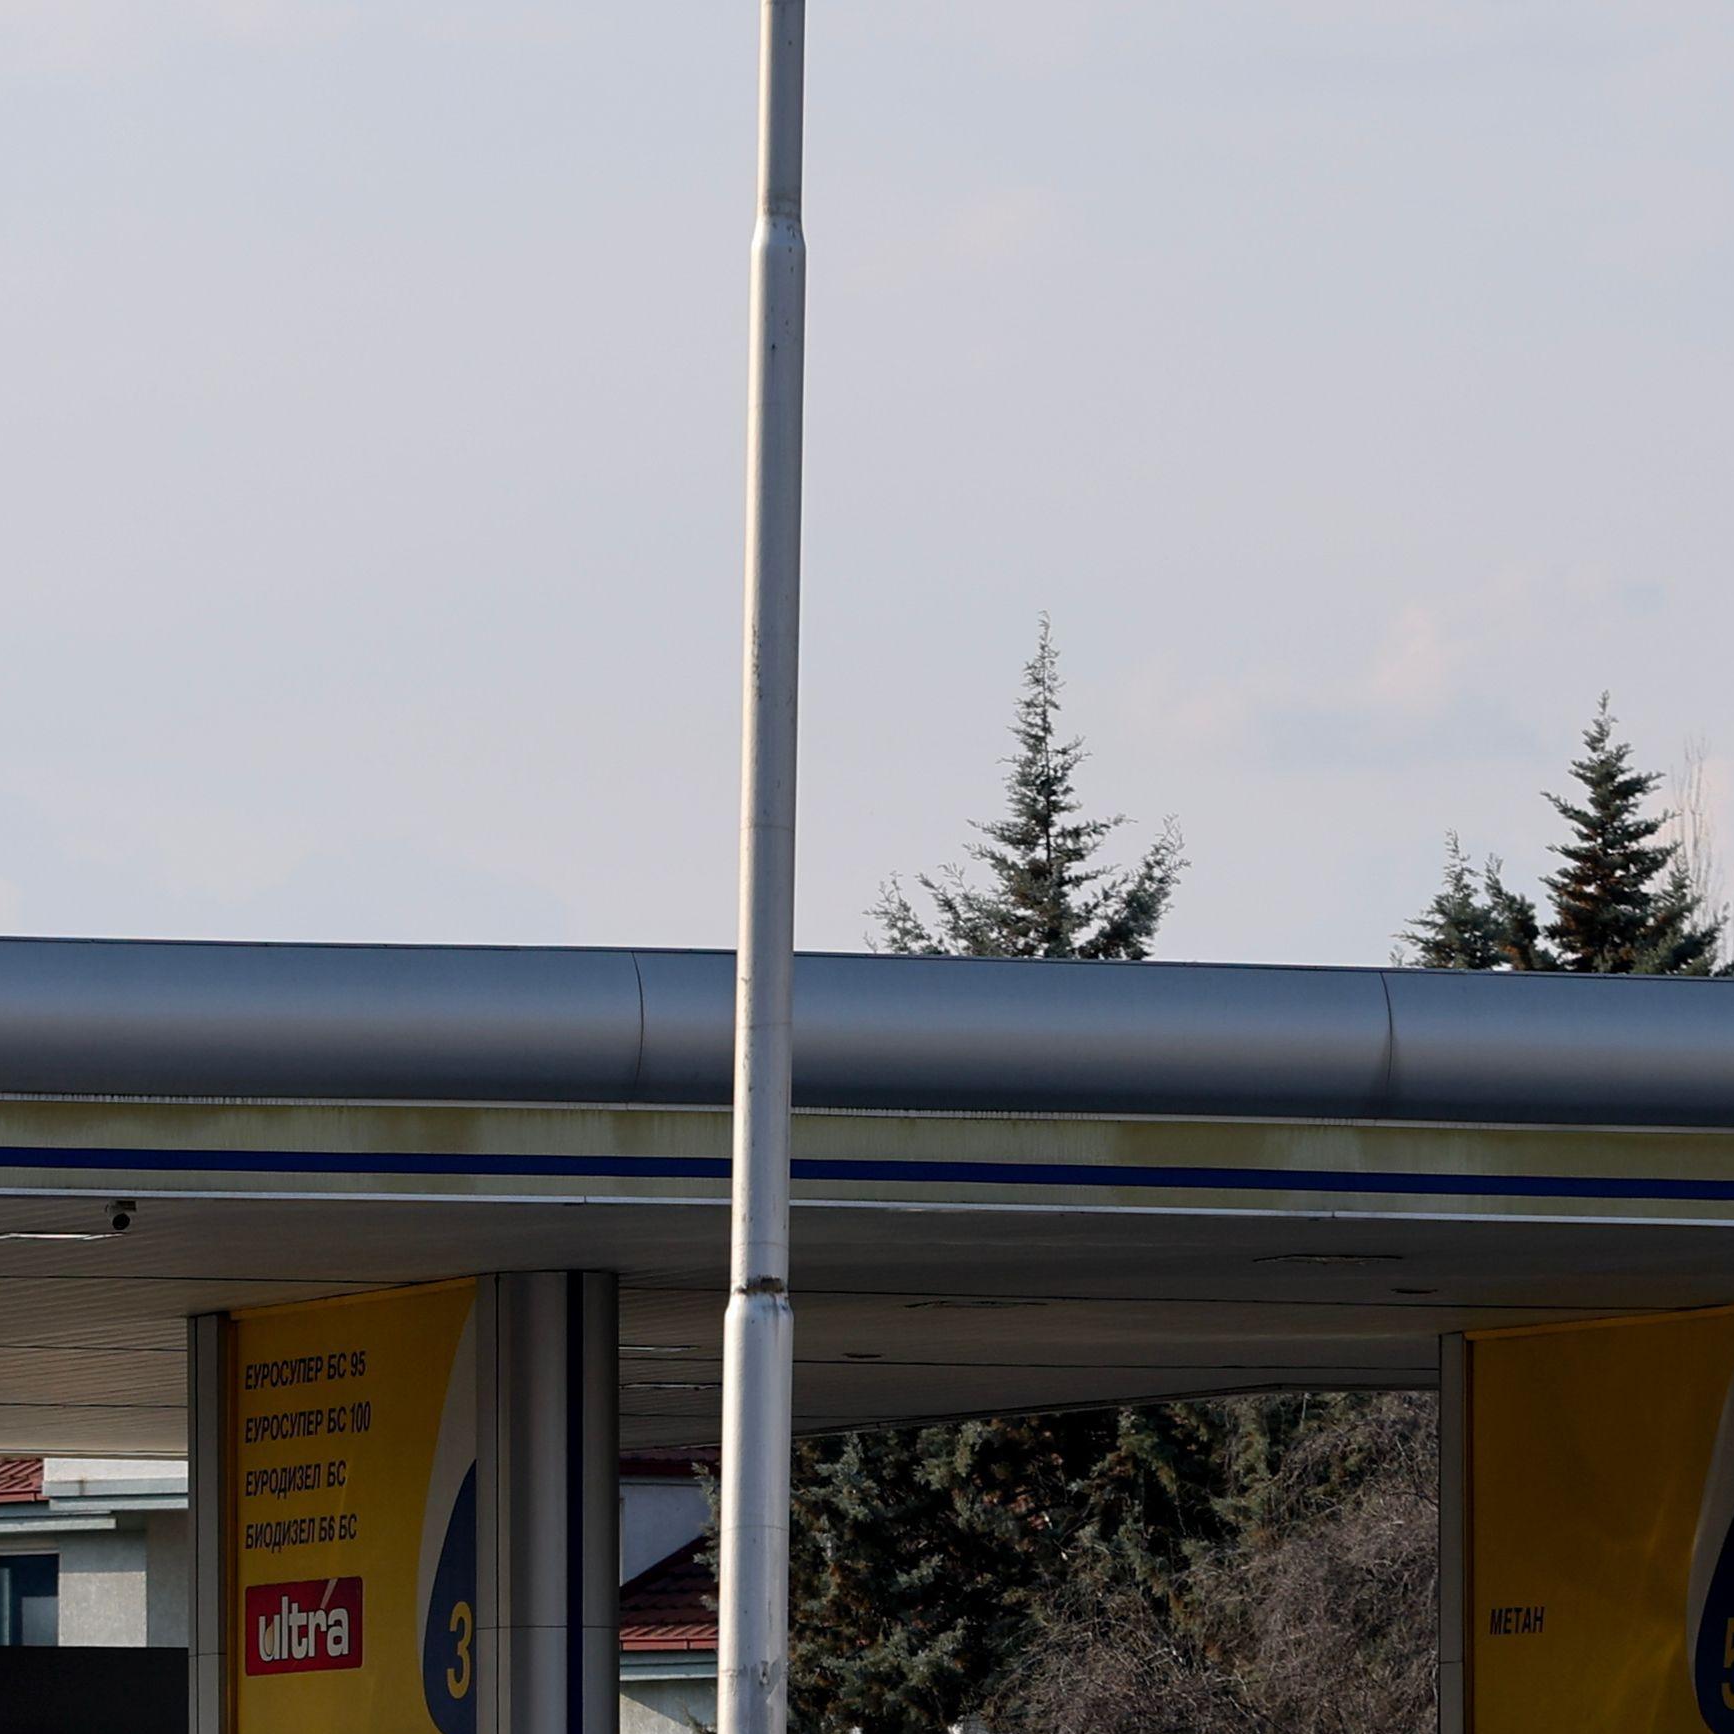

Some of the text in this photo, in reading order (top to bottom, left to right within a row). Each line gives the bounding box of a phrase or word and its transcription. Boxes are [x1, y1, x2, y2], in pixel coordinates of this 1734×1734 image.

[245, 1350, 367, 1391] ЕУРОСУПЕР БС 95
[245, 1401, 372, 1444] ЕУРОСУПЕР БС 100
[245, 1459, 347, 1500] ЕУРОДИЗЕЛ БС
[245, 1513, 357, 1554] БИОДИЗЕЛ Б6 БС
[258, 1595, 350, 1662] ultra
[1489, 1606, 1545, 1636] МЕТАН
[446, 1601, 473, 1699] 3
